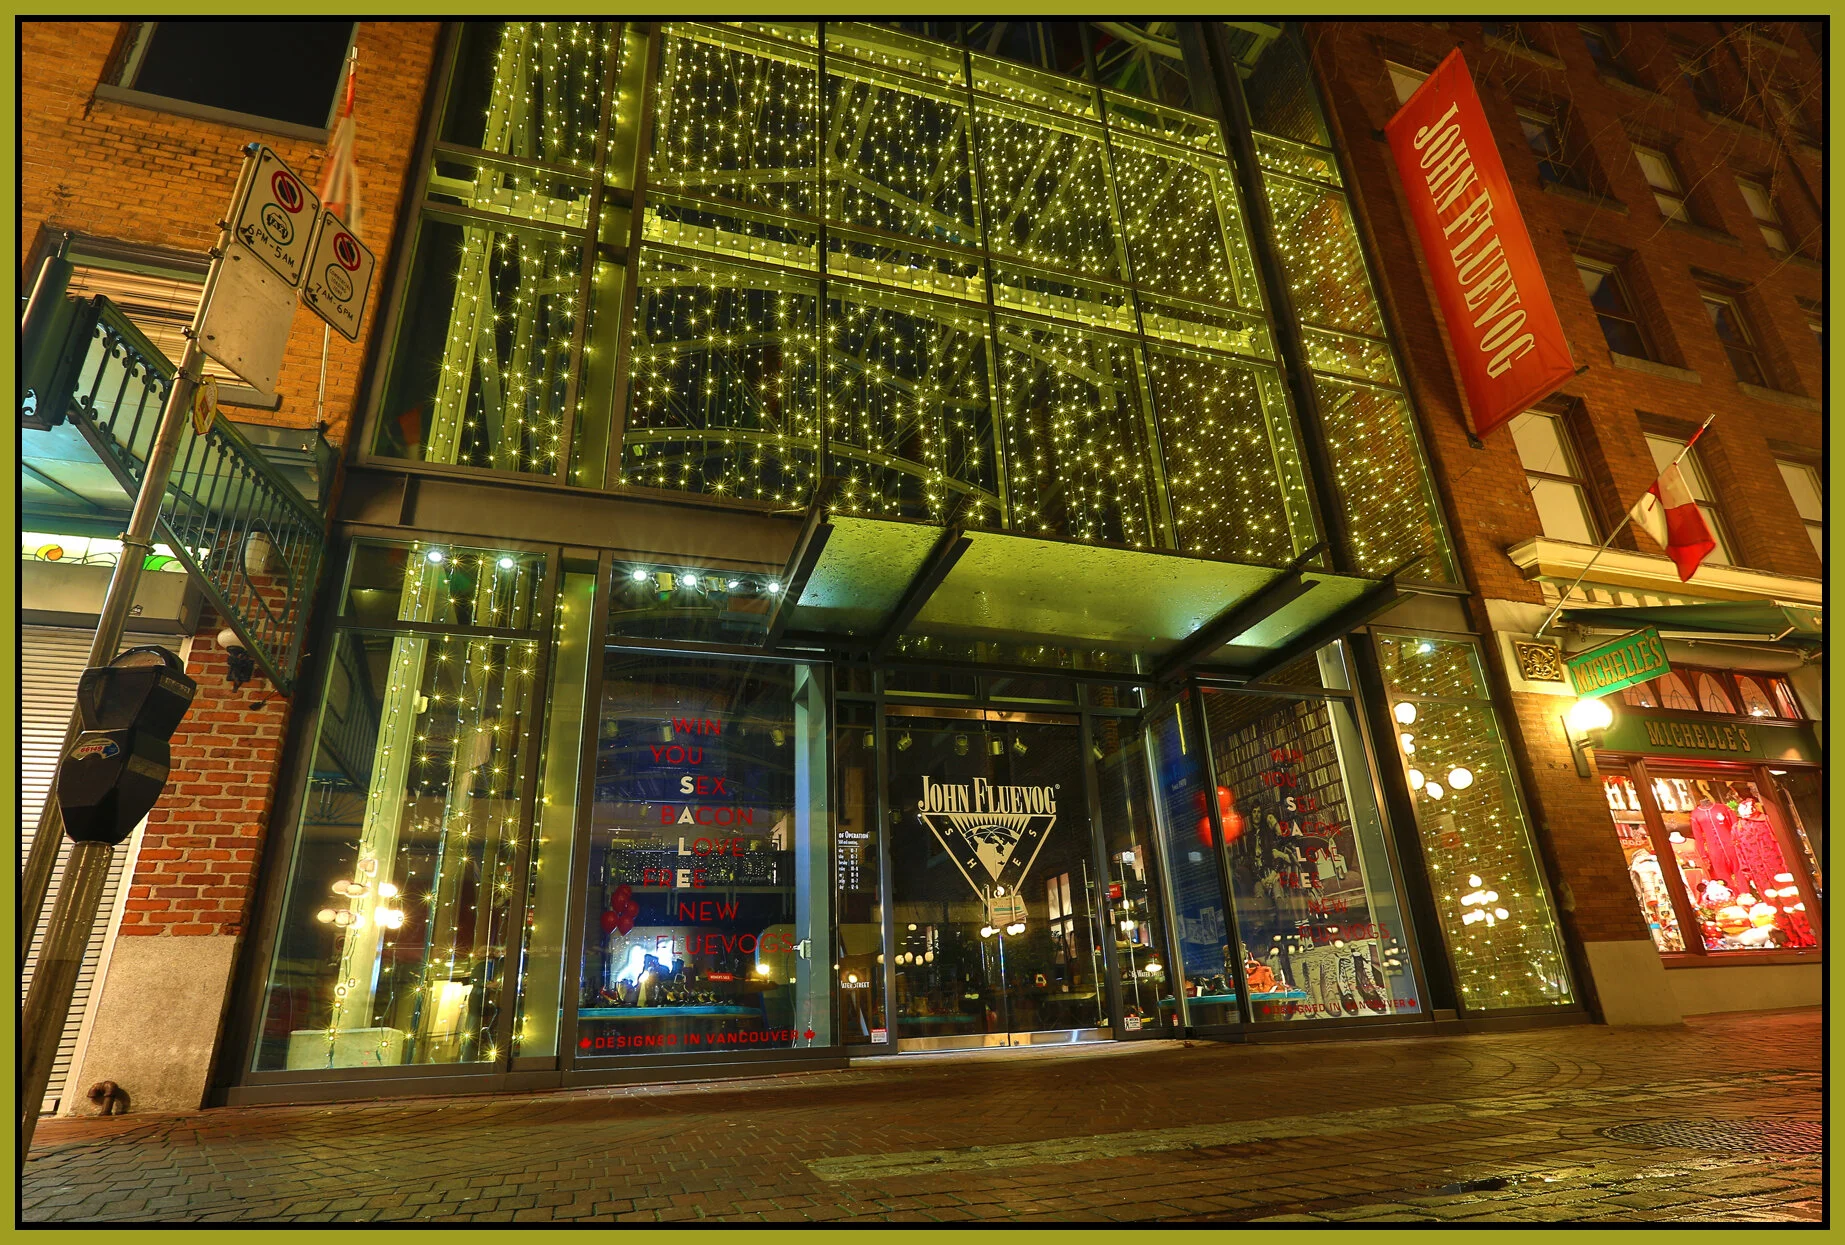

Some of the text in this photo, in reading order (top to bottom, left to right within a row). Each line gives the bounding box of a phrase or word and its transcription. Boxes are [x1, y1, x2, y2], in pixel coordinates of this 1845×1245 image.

[1413, 101, 1536, 379] JOHN FLUEVOG
[1571, 635, 1664, 694] MICHELLE'S
[671, 716, 721, 736] WIN
[1644, 720, 1751, 752] MICHELLE'S
[650, 745, 703, 765] YOU
[1269, 748, 1305, 763] WIN
[680, 776, 726, 795] SEX
[1260, 771, 1297, 787] YOU
[918, 775, 1057, 814] JOHN FLUEVOG
[1286, 796, 1319, 812] SEX
[661, 805, 753, 826] BACON
[1278, 819, 1342, 837] BACON
[678, 837, 745, 857] LOVE
[1295, 846, 1342, 862] LOVE
[643, 868, 707, 889] FREE
[1279, 872, 1322, 889] FREE
[679, 901, 739, 921] NEW
[1308, 898, 1347, 914] NEW
[656, 933, 794, 955] FLUEVOGS
[1329, 1002, 1340, 1012] IN
[595, 1029, 799, 1049] DESIGNED IN VANCOUVER
